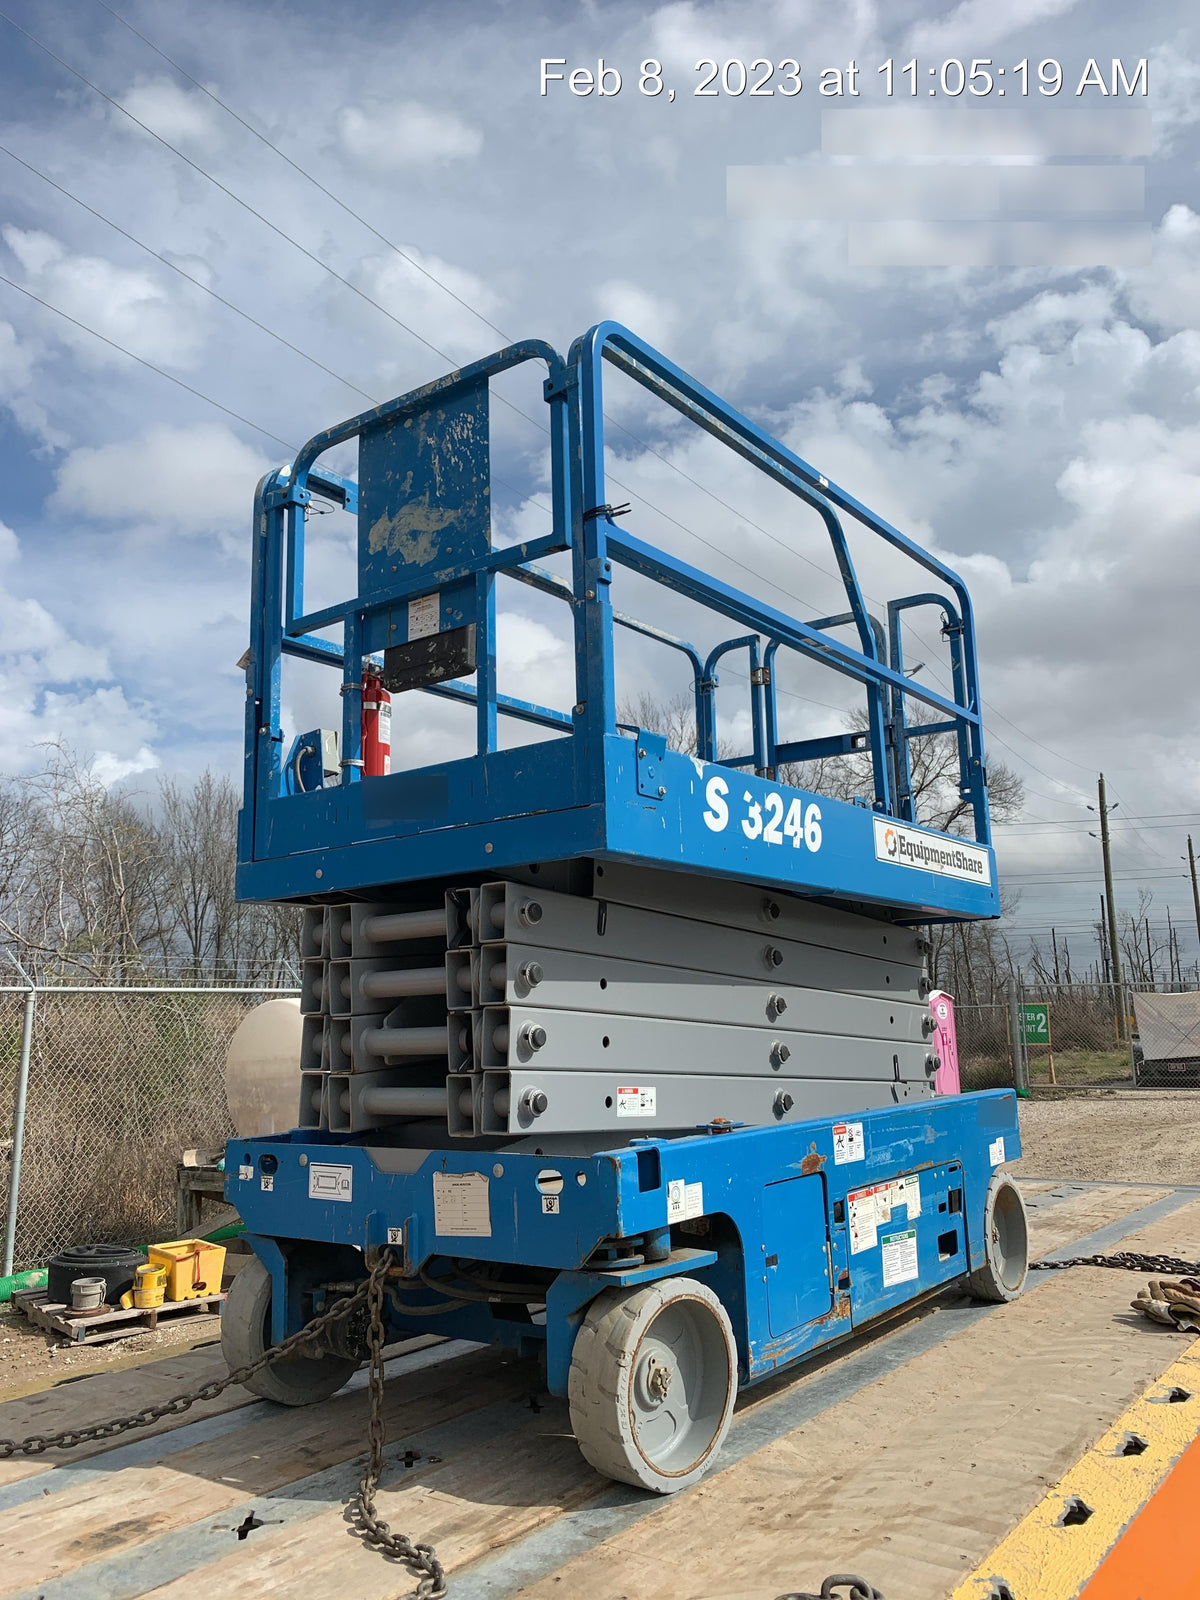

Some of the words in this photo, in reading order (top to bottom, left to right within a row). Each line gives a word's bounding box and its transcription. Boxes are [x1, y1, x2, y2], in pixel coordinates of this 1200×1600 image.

[703, 776, 729, 832] S
[741, 790, 822, 853] 3246
[899, 835, 983, 874] EquipmentShare
[1036, 1013, 1047, 1033] 2
